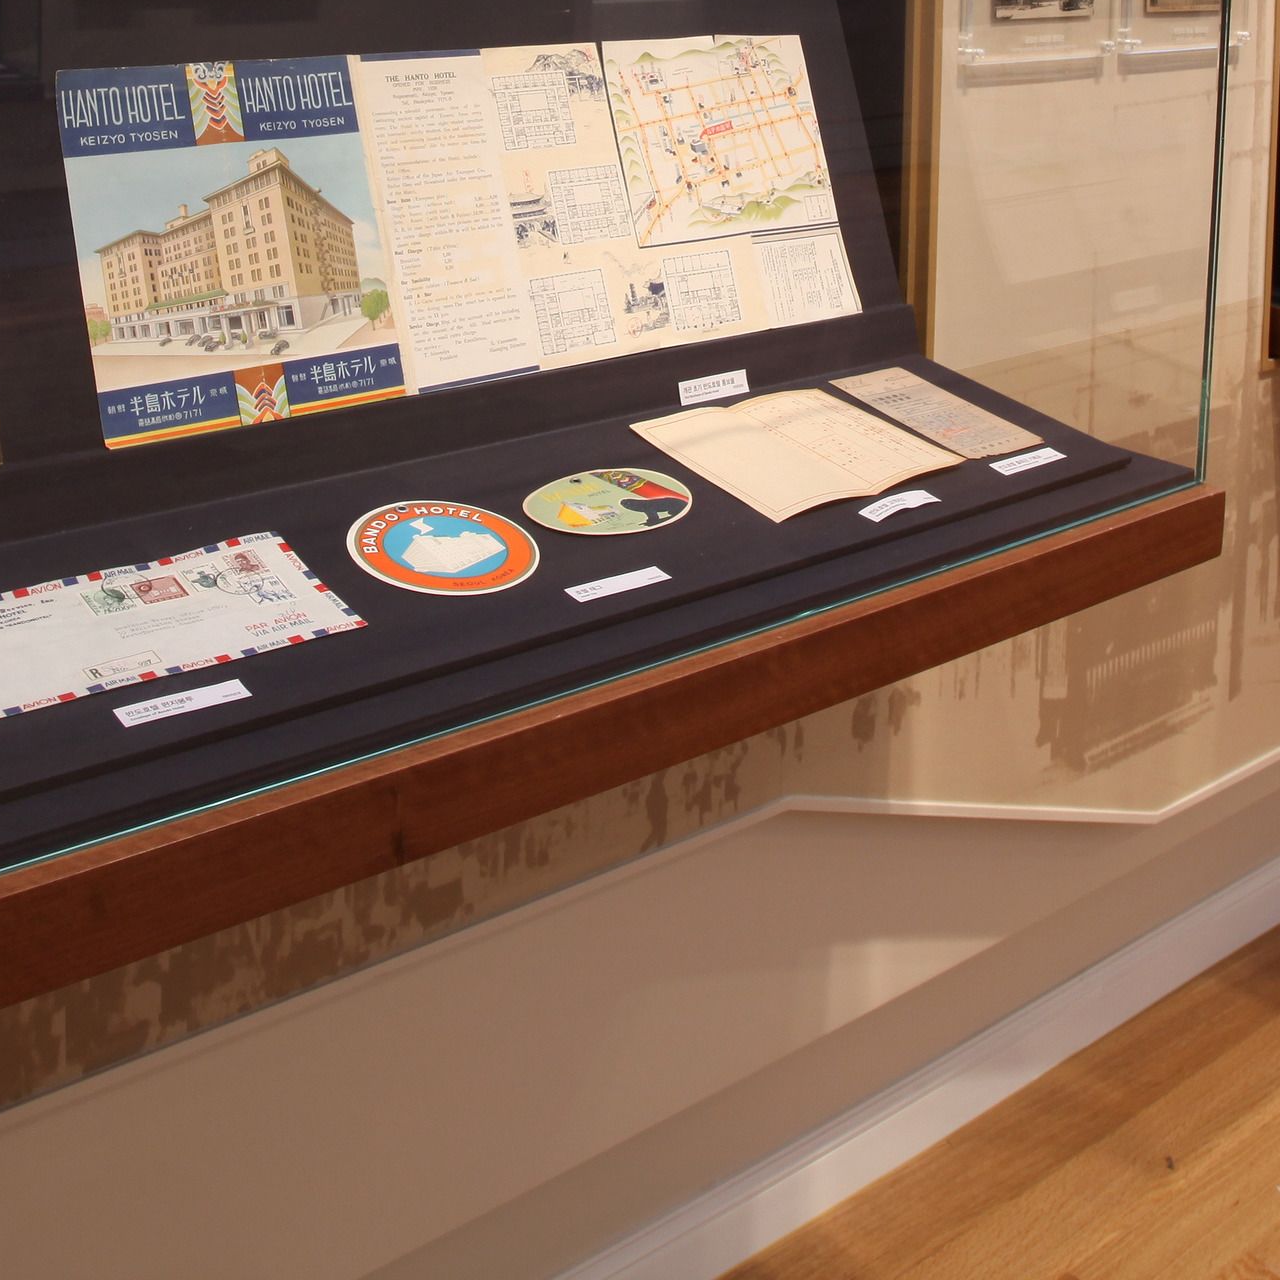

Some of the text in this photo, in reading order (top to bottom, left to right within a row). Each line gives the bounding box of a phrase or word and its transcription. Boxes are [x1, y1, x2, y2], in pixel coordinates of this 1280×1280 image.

[61, 84, 185, 128] HANTO HOTEL
[241, 71, 353, 113] HANTO HOTEL
[80, 130, 178, 146] KEIZYO TYOSEN
[259, 116, 345, 131] KEIZYO TYOSEN
[310, 355, 376, 384] 半島ホテル
[129, 385, 206, 414] 半島ホテル
[363, 506, 483, 554] BANDO HOTEL
[245, 612, 307, 633] PAR AVION
